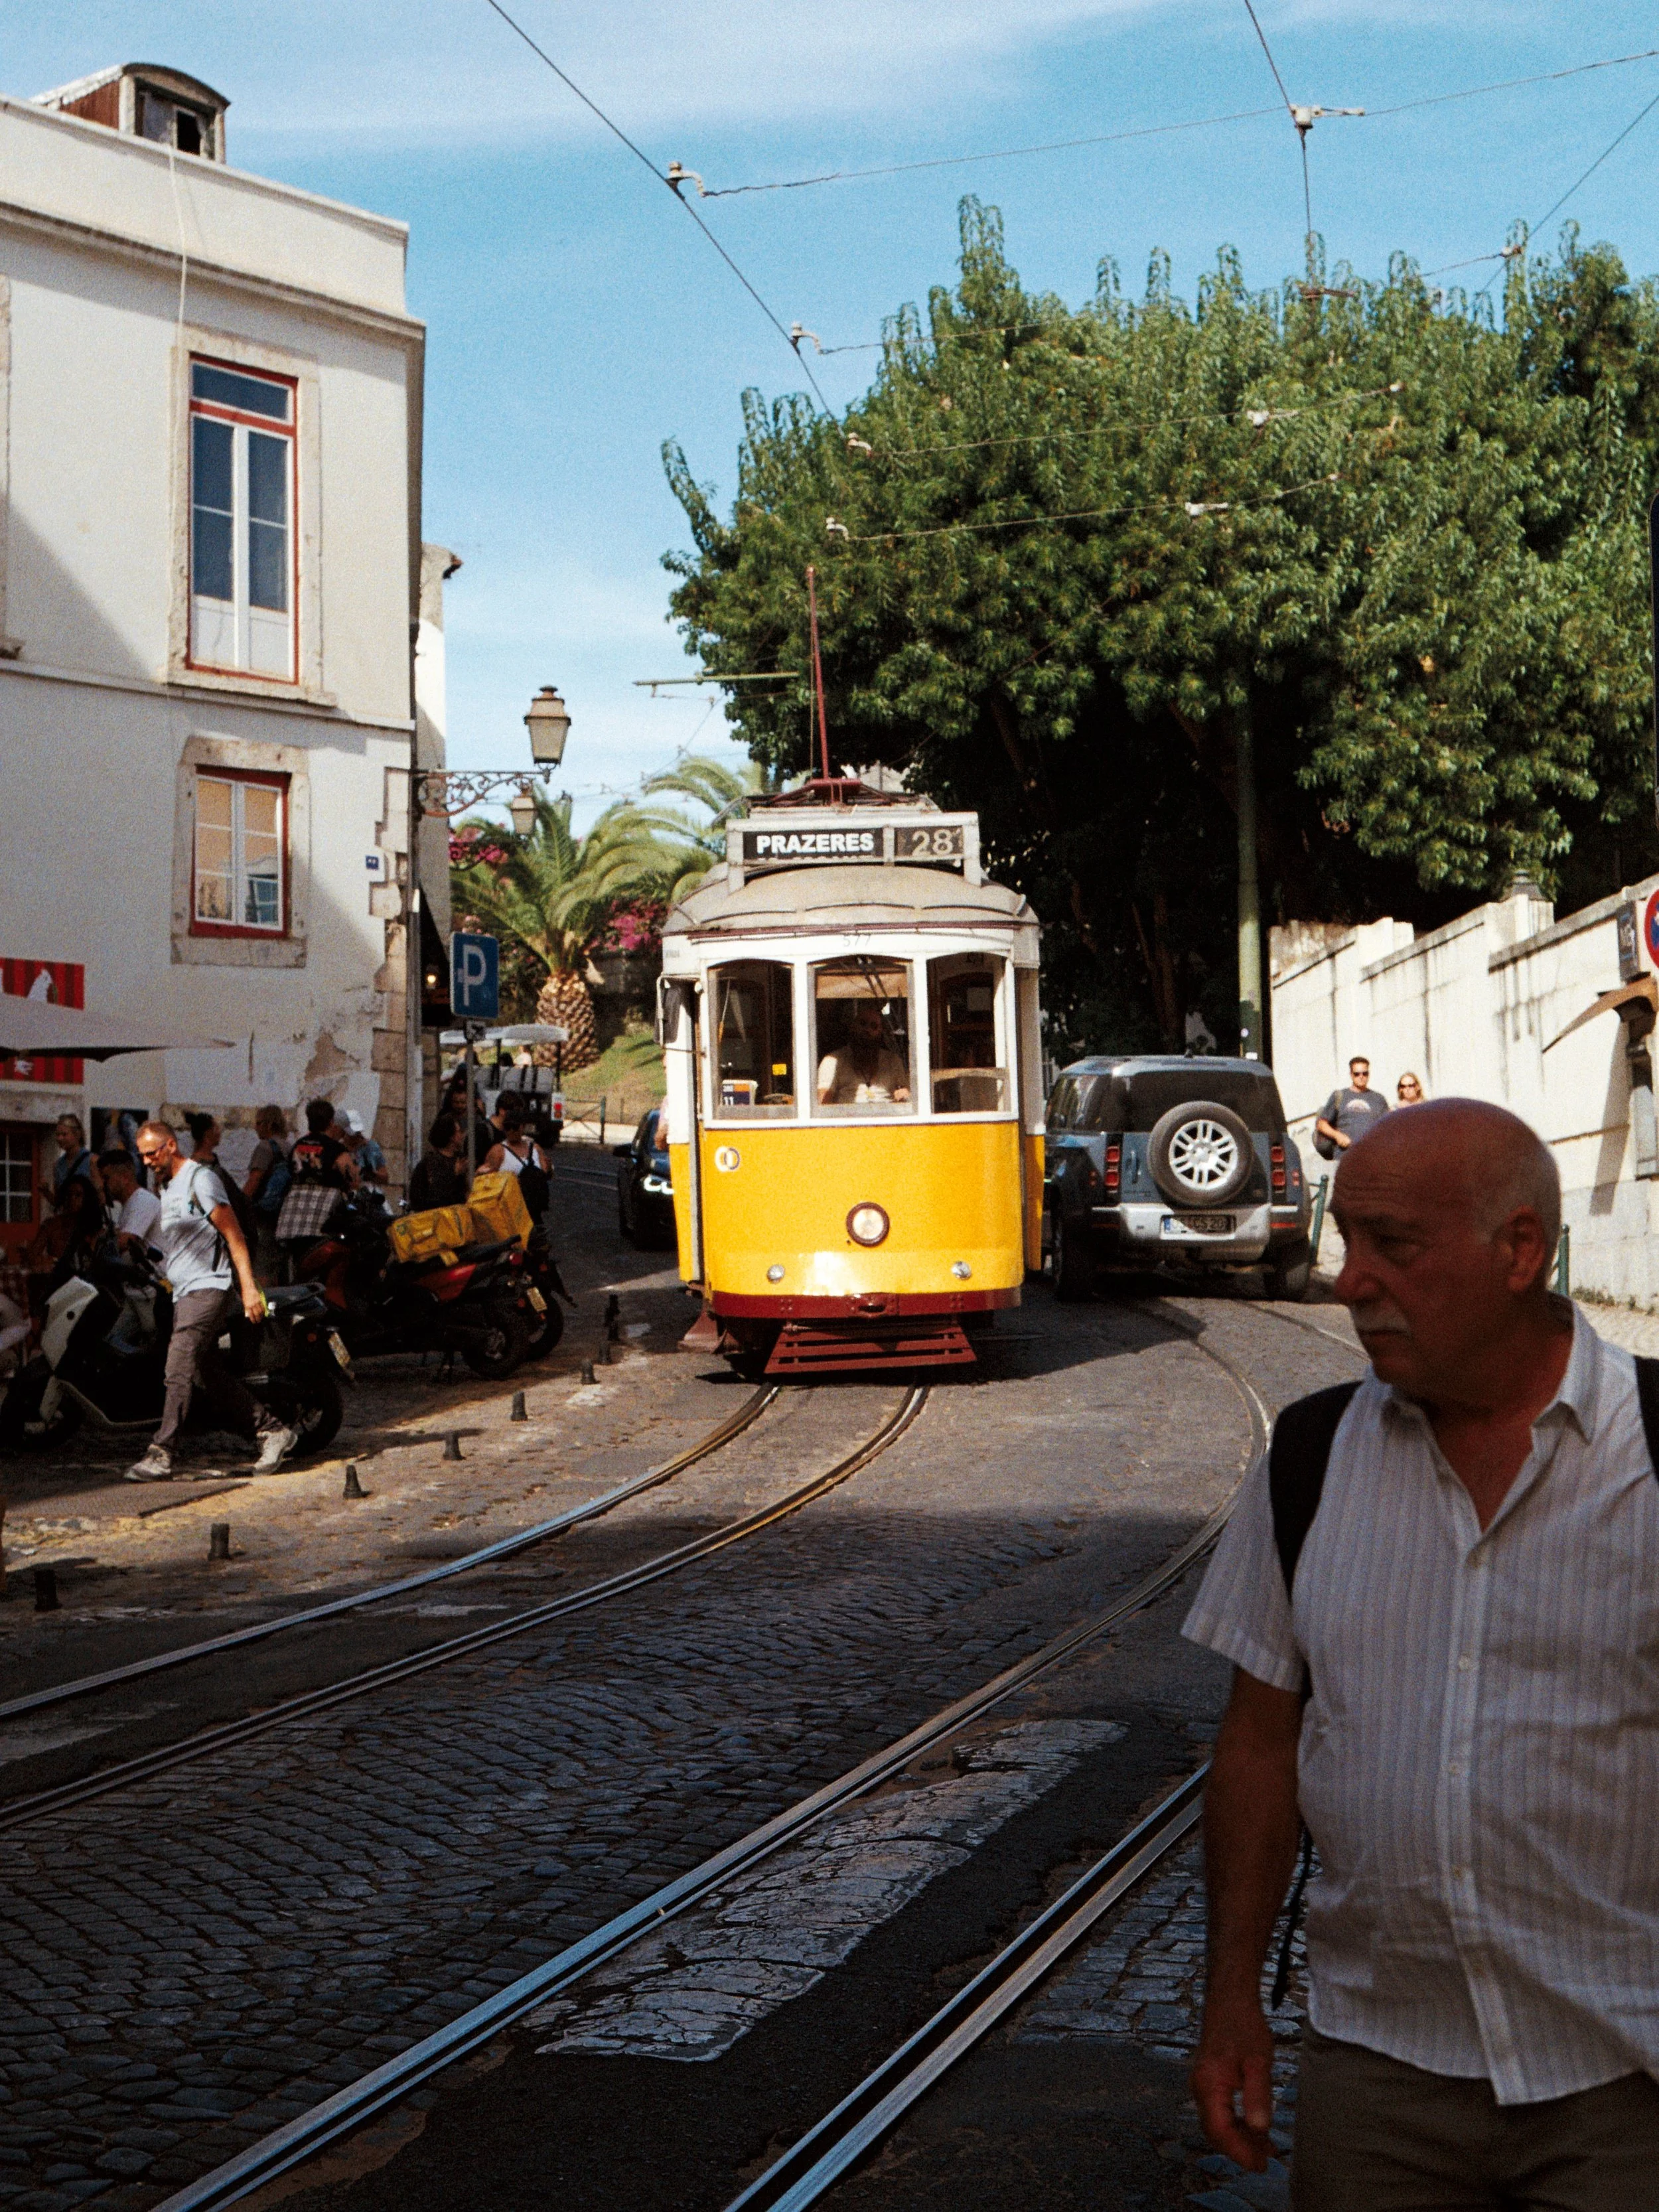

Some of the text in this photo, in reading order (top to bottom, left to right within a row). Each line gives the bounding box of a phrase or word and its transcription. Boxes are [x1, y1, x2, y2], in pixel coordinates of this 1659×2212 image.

[757, 829, 953, 856] PRAZERES 28
[463, 943, 486, 1007] P
